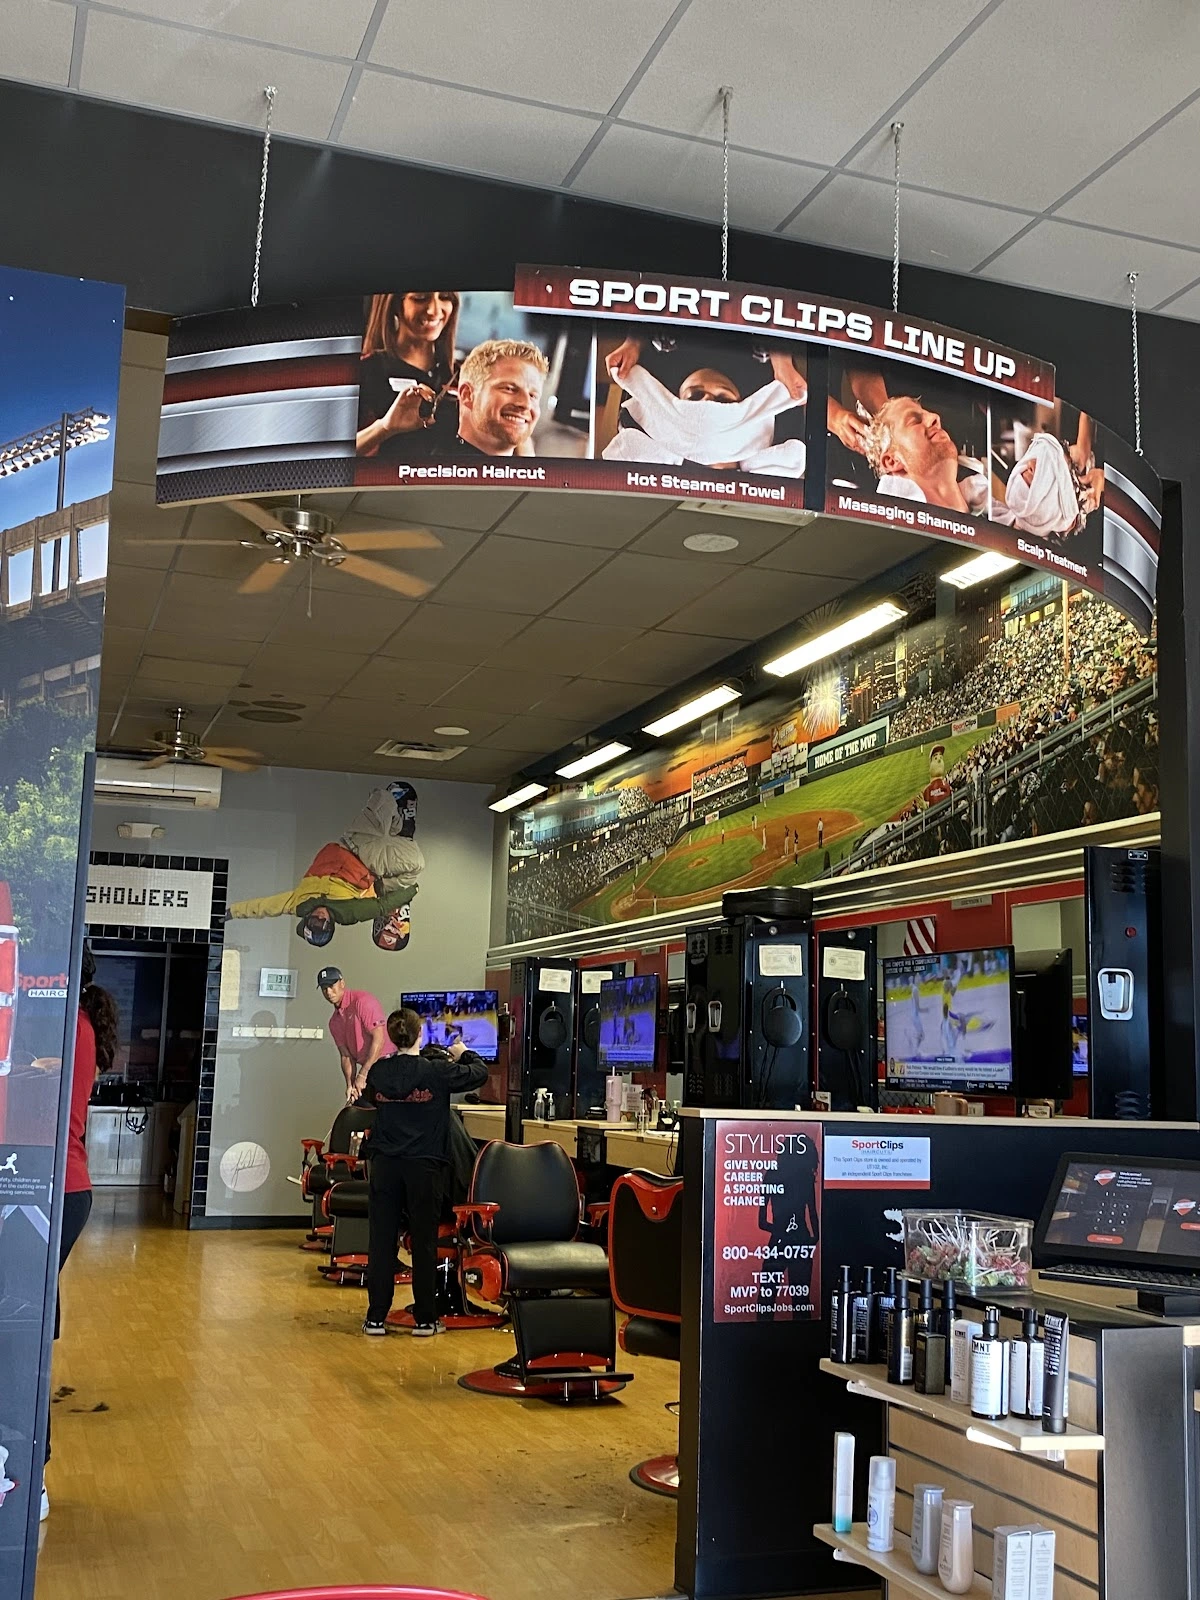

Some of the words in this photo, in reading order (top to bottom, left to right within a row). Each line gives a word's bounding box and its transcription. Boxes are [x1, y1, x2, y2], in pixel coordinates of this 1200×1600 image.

[569, 278, 730, 317] SPORT
[741, 294, 873, 342] CLIPS
[883, 320, 965, 367] LINE
[973, 346, 1016, 379] UP
[399, 465, 478, 479] Precision
[482, 465, 546, 480] Haircut
[627, 472, 657, 487] Hot
[661, 474, 735, 494] Steamed
[739, 482, 785, 500] Towel
[839, 496, 915, 524] Massaging
[917, 511, 975, 536] Shampoo
[1017, 538, 1045, 559] Scalp
[1045, 549, 1088, 577] Treatment
[814, 753, 834, 769] HOME
[835, 748, 844, 761] OF
[844, 742, 860, 758] THE
[860, 733, 877, 752] MVP
[86, 885, 188, 907] SHOWERS
[725, 1133, 807, 1154] STYLISTS
[852, 1140, 904, 1151] SportClips
[723, 1160, 750, 1170] GIVE
[750, 1160, 778, 1170] YOUR
[723, 1172, 763, 1182] CAREER
[723, 1184, 731, 1194] A
[733, 1184, 784, 1194] SPORTING
[723, 1196, 765, 1206] CHANCE
[722, 1245, 816, 1260] 800-434-0757
[752, 1272, 785, 1283] TEXT:
[730, 1286, 757, 1298] MVP
[760, 1287, 772, 1297] to
[776, 1285, 809, 1296] 77039
[724, 1303, 815, 1314] SportClipsJobs.com
